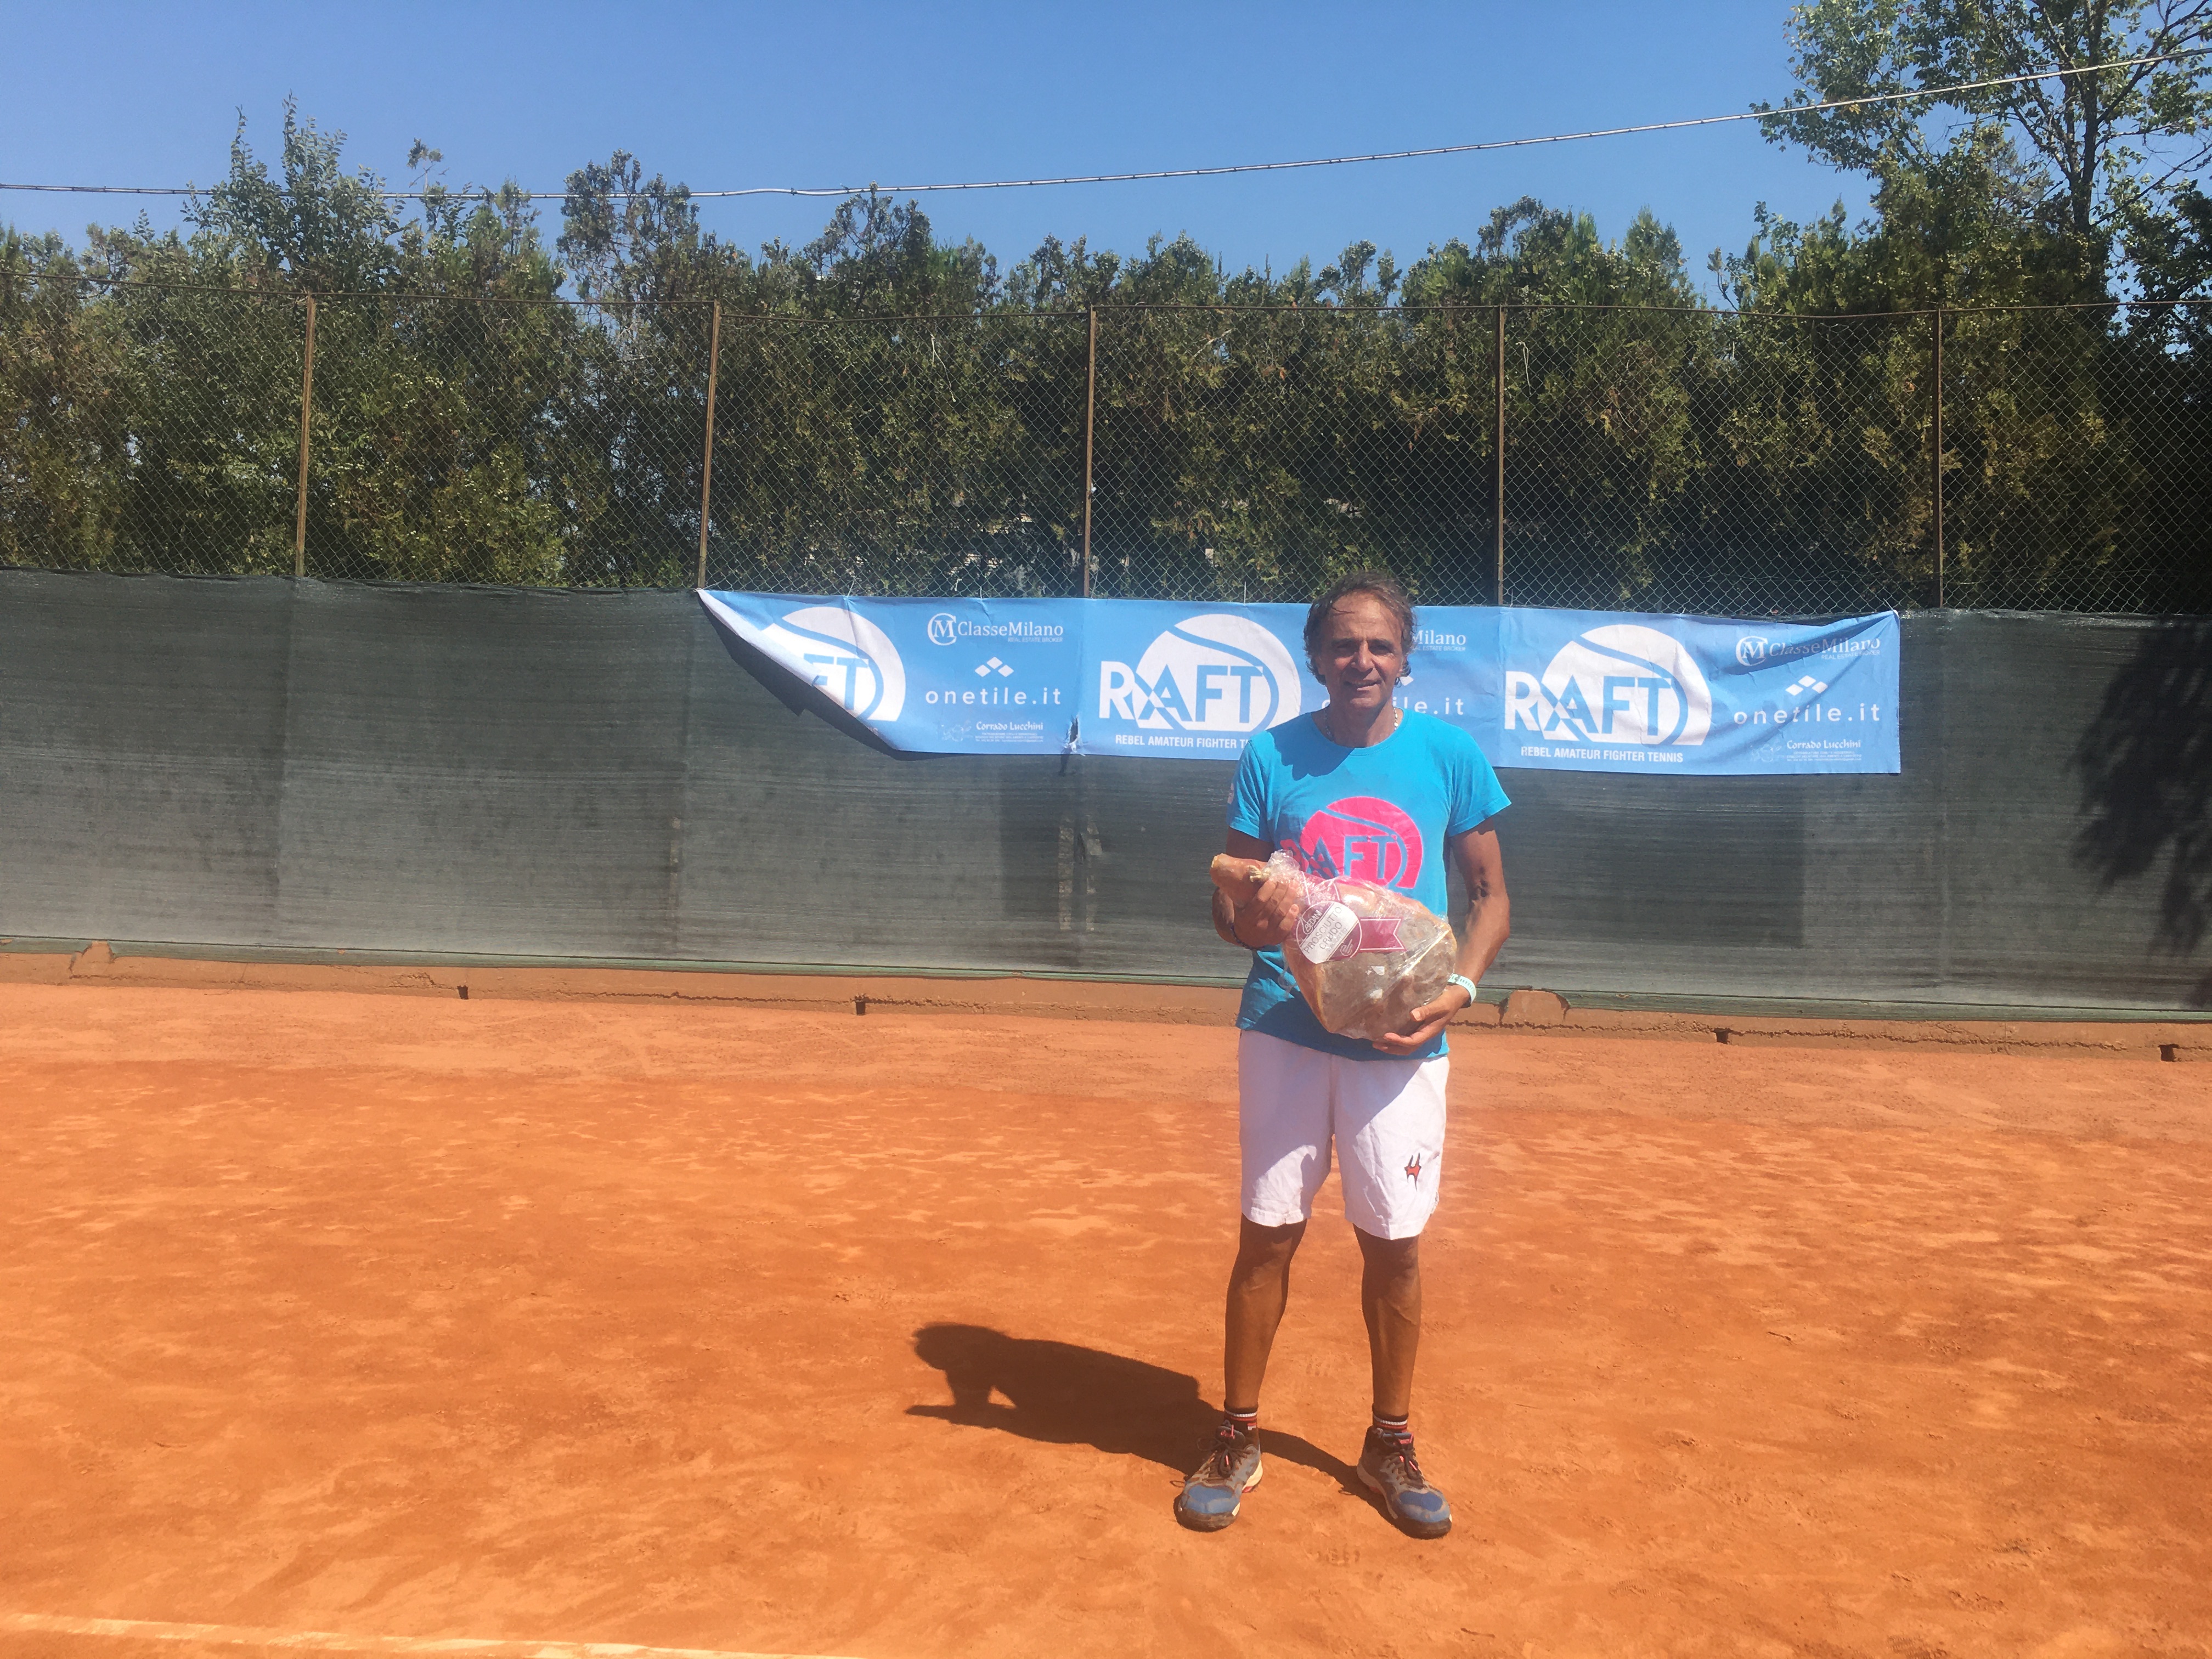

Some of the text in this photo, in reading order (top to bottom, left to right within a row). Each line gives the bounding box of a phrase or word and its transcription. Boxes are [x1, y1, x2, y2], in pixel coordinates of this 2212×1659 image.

[958, 621, 1063, 636] ClasseMilano
[1412, 630, 1466, 645] Milano
[1769, 638, 1880, 656] ClasseMilano
[926, 687, 1061, 705] onetile.it
[1099, 661, 1263, 723] RAFT
[1504, 670, 1672, 737] RAFT
[1734, 702, 1880, 725] onetile.it
[976, 721, 1043, 730] Corrado Lucchini
[1115, 735, 1146, 746] REBEL
[1148, 737, 1194, 748] AMATEUR
[1197, 738, 1237, 749] FIGHTER
[1786, 738, 1861, 749] Corrado Lucchini
[1521, 746, 1683, 763] REBEL AMATEUR FIGHTER TENNIS
[1304, 906, 1342, 954] PROSCIUTTO
[1319, 922, 1342, 950] CRUDO
